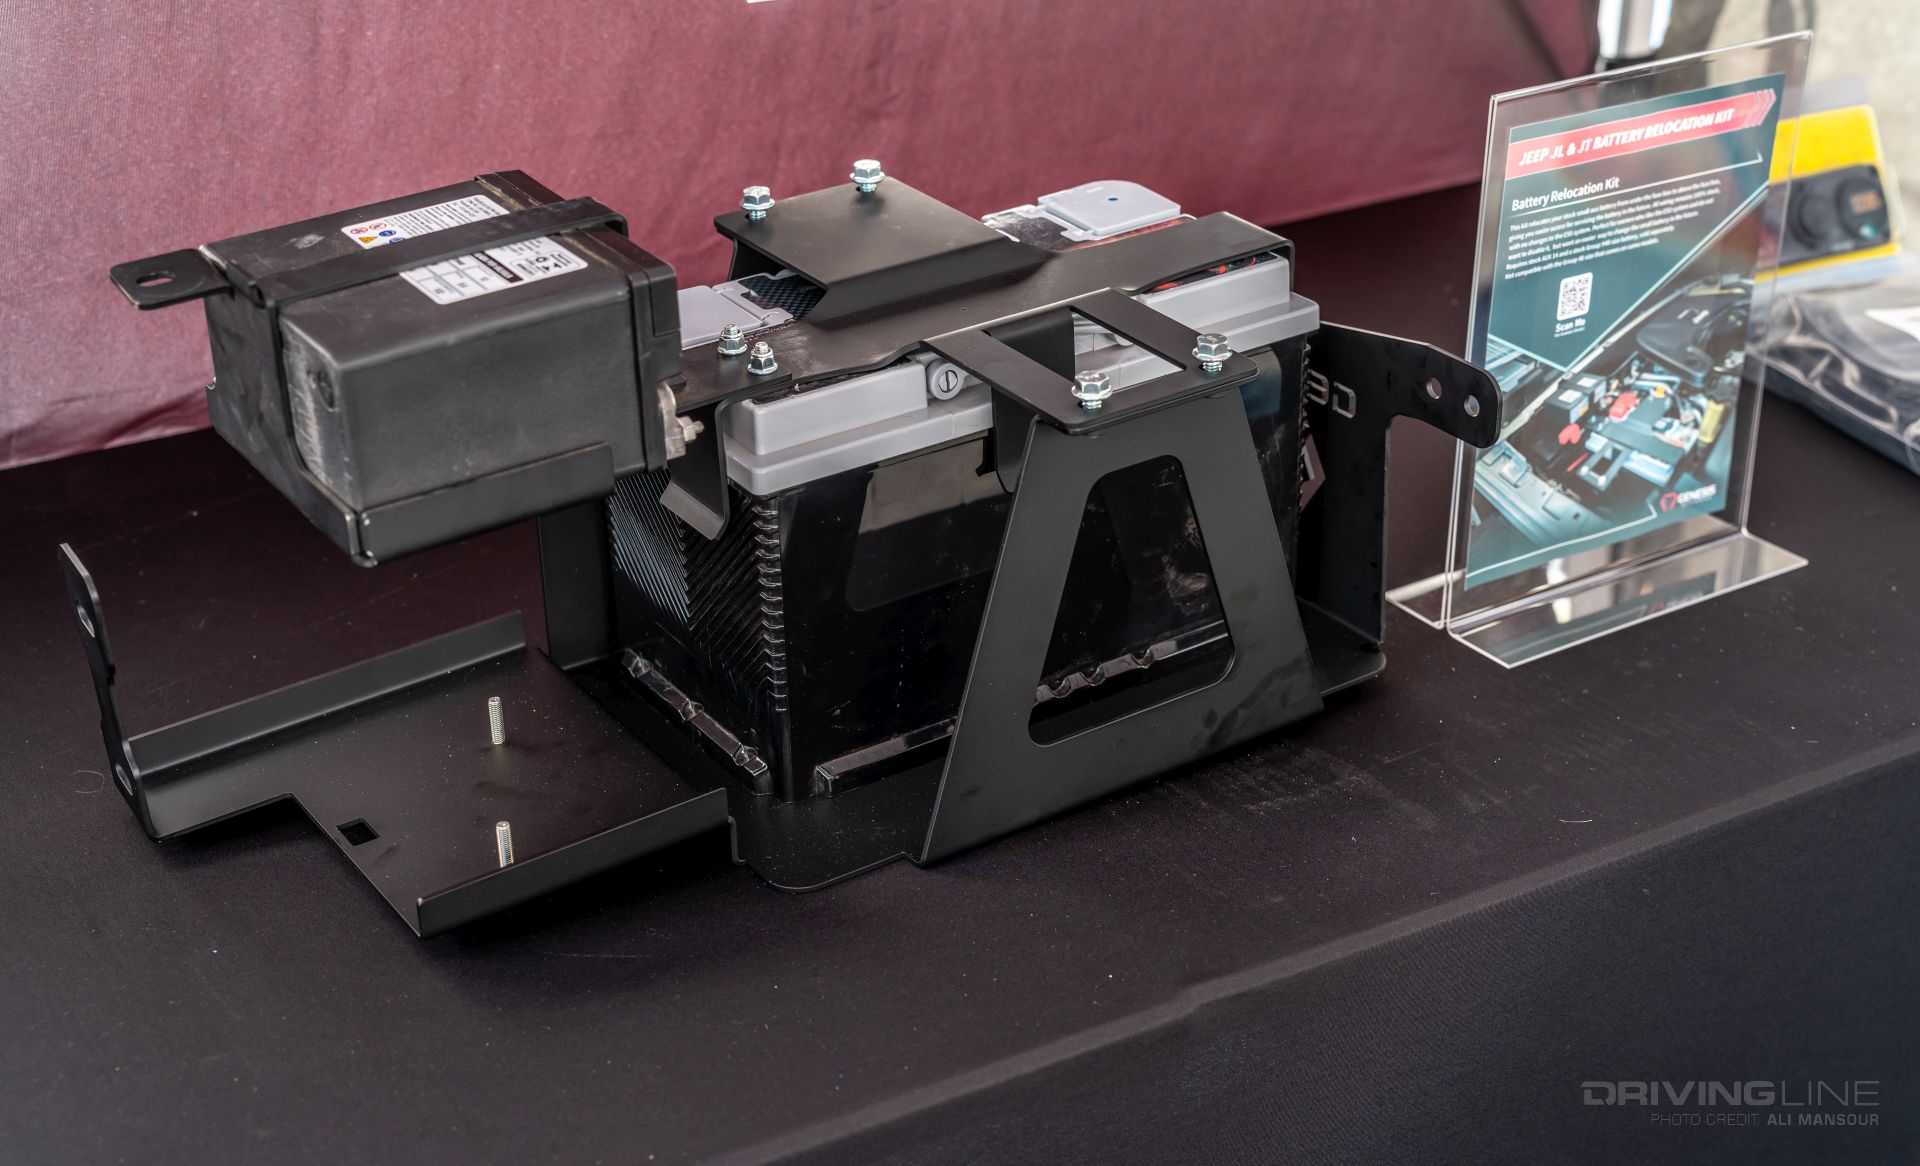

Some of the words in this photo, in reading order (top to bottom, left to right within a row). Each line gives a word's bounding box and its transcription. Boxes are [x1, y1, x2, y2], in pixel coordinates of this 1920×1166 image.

[1519, 147, 1552, 166] JEEP
[1550, 145, 1565, 161] JL
[1566, 143, 1577, 156] &
[1577, 138, 1594, 155] JT
[1593, 126, 1645, 150] BATTERY
[1644, 112, 1715, 140] RELOCATION
[1714, 108, 1735, 123] KIT
[1511, 194, 1549, 212] Battery
[1550, 181, 1603, 203] Relocation
[1604, 176, 1620, 190] Kit
[1555, 322, 1573, 333] Scan
